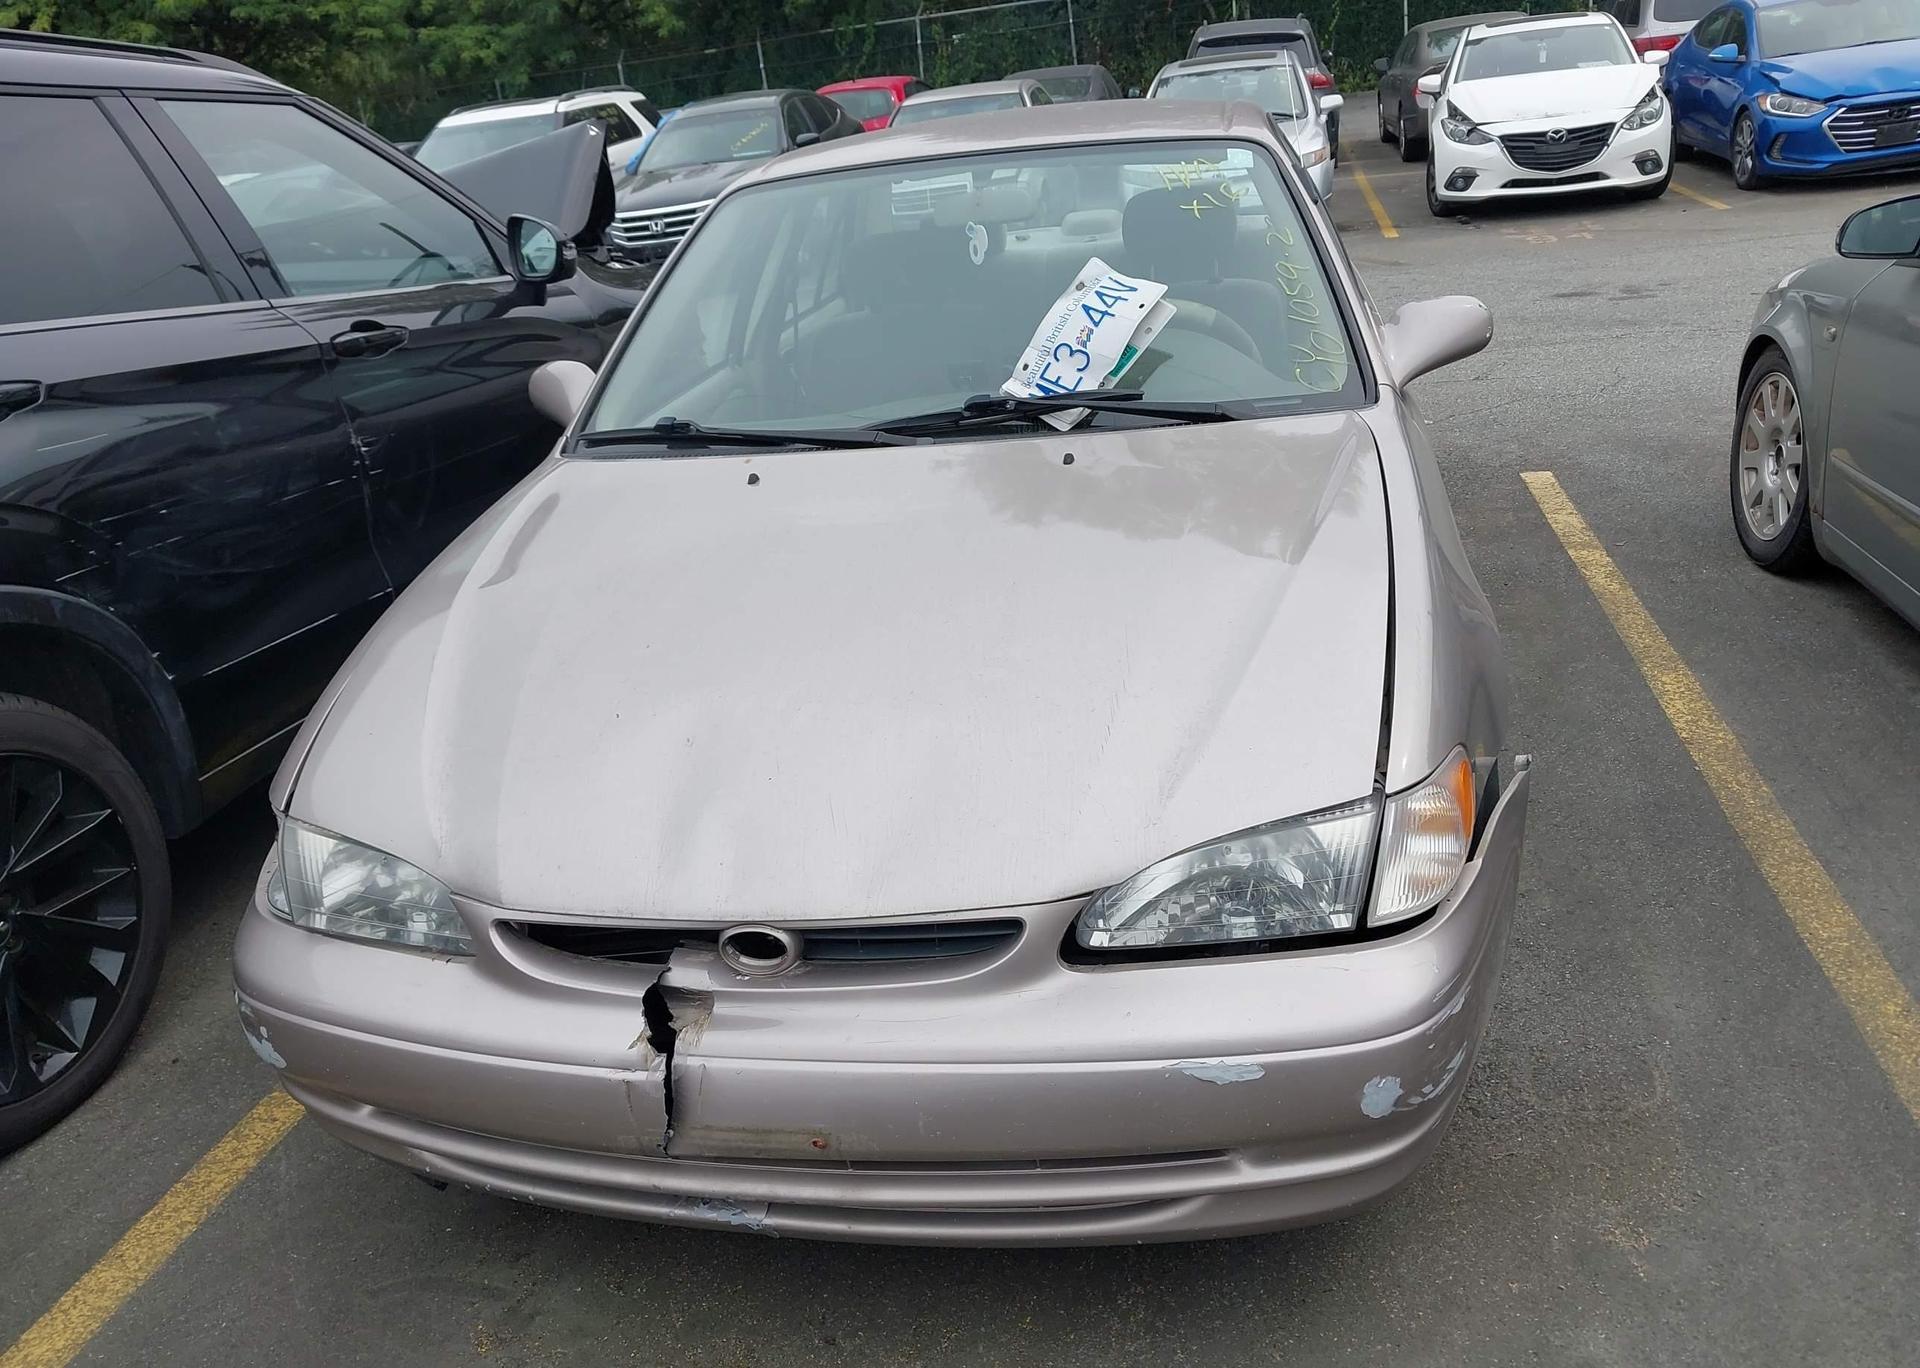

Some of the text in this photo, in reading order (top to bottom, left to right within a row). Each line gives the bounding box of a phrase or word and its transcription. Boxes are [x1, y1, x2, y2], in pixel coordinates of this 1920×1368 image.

[1021, 276, 1101, 390] Beautiful British Columbia
[1081, 276, 1138, 328] 44V
